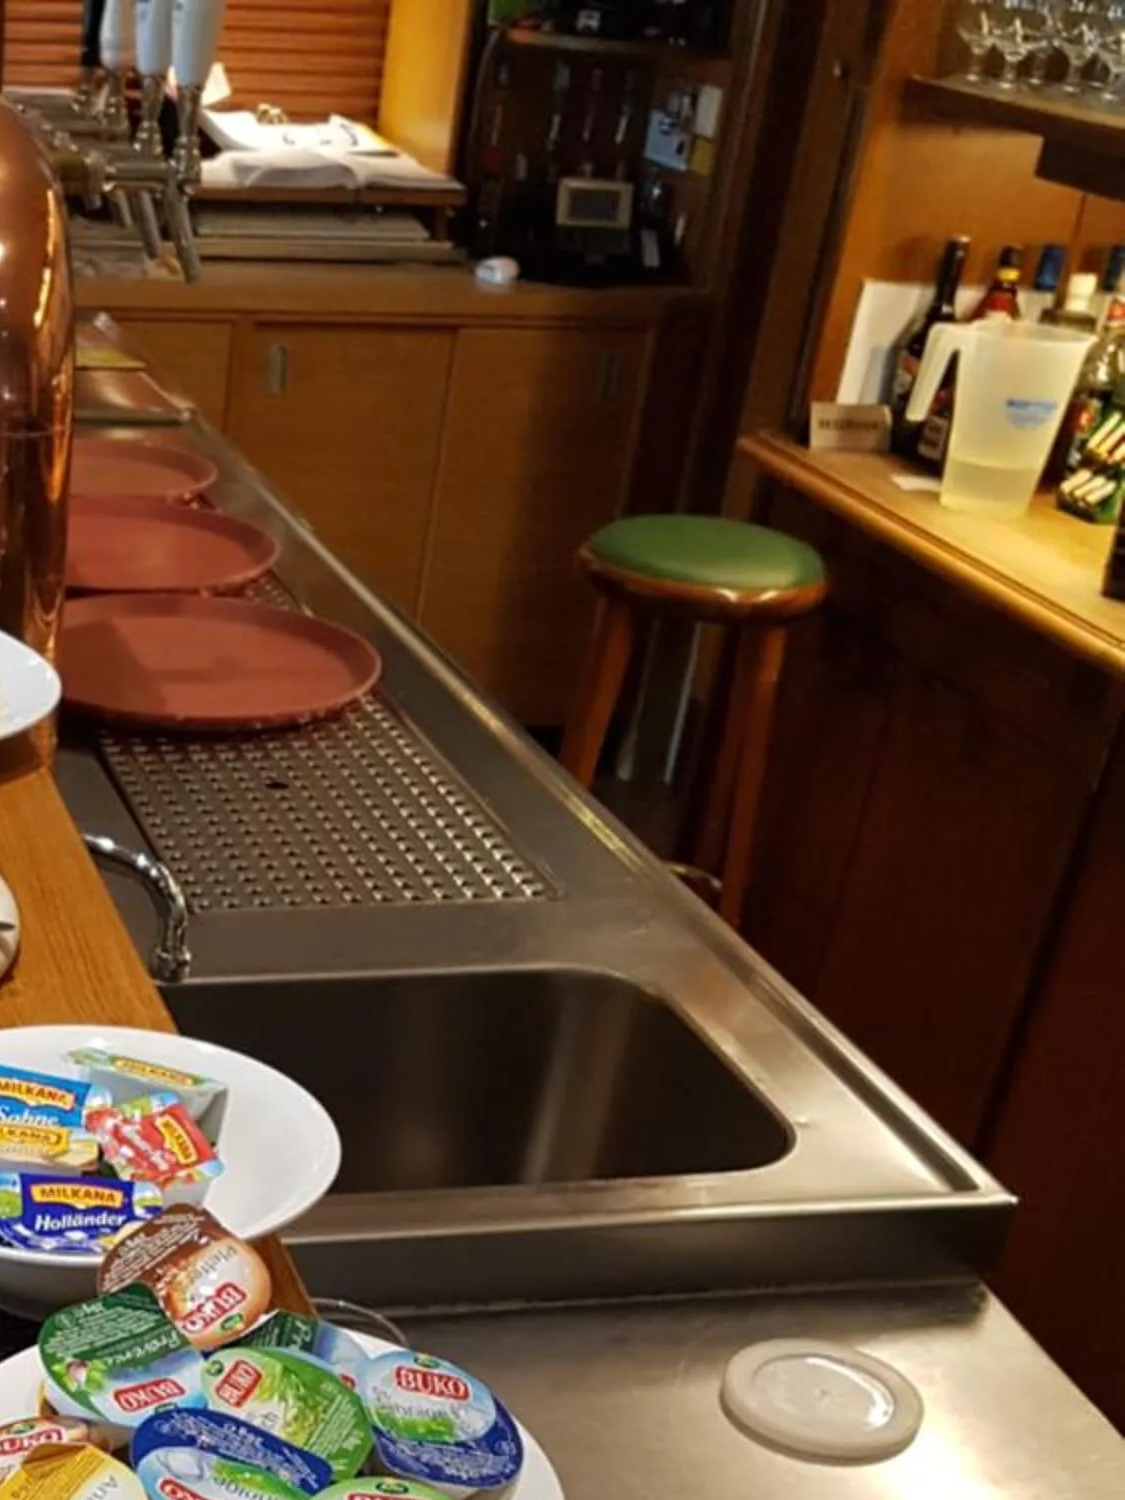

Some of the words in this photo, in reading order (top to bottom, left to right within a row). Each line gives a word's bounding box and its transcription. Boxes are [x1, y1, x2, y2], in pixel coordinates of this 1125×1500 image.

[39, 1186, 117, 1203] MILKANA
[35, 1212, 126, 1231] Holländer
[401, 1368, 467, 1398] BUKO
